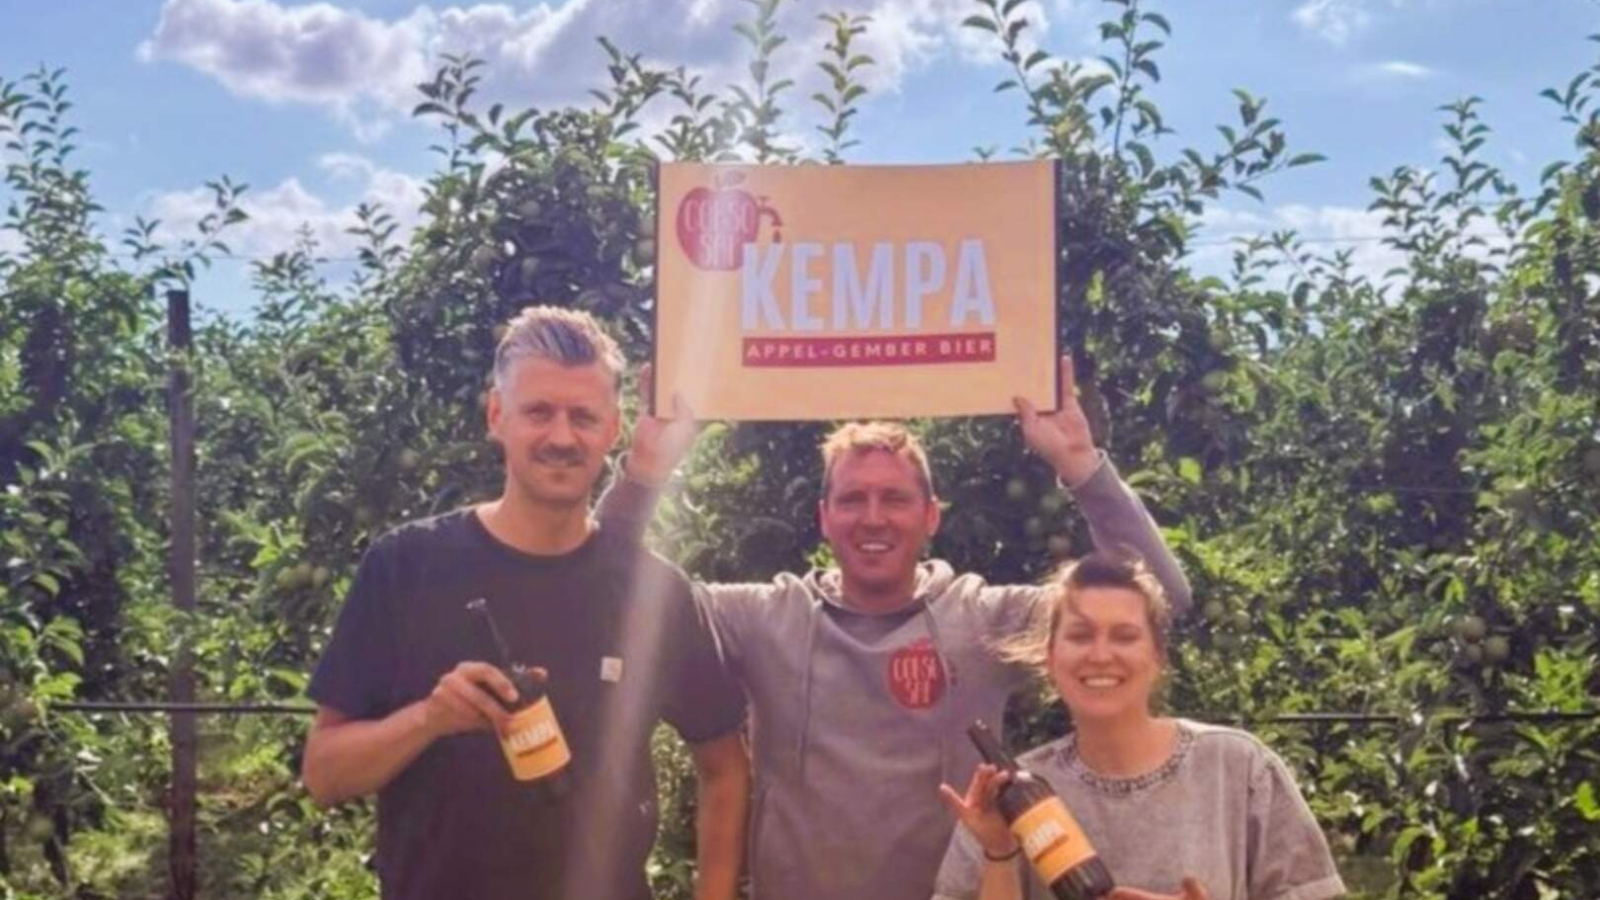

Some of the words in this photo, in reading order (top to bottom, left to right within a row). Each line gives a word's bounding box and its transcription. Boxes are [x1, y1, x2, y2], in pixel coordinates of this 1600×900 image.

[742, 238, 995, 331] KEMPA
[747, 341, 928, 359] APPEL-GEMBER
[939, 338, 993, 355] BIER
